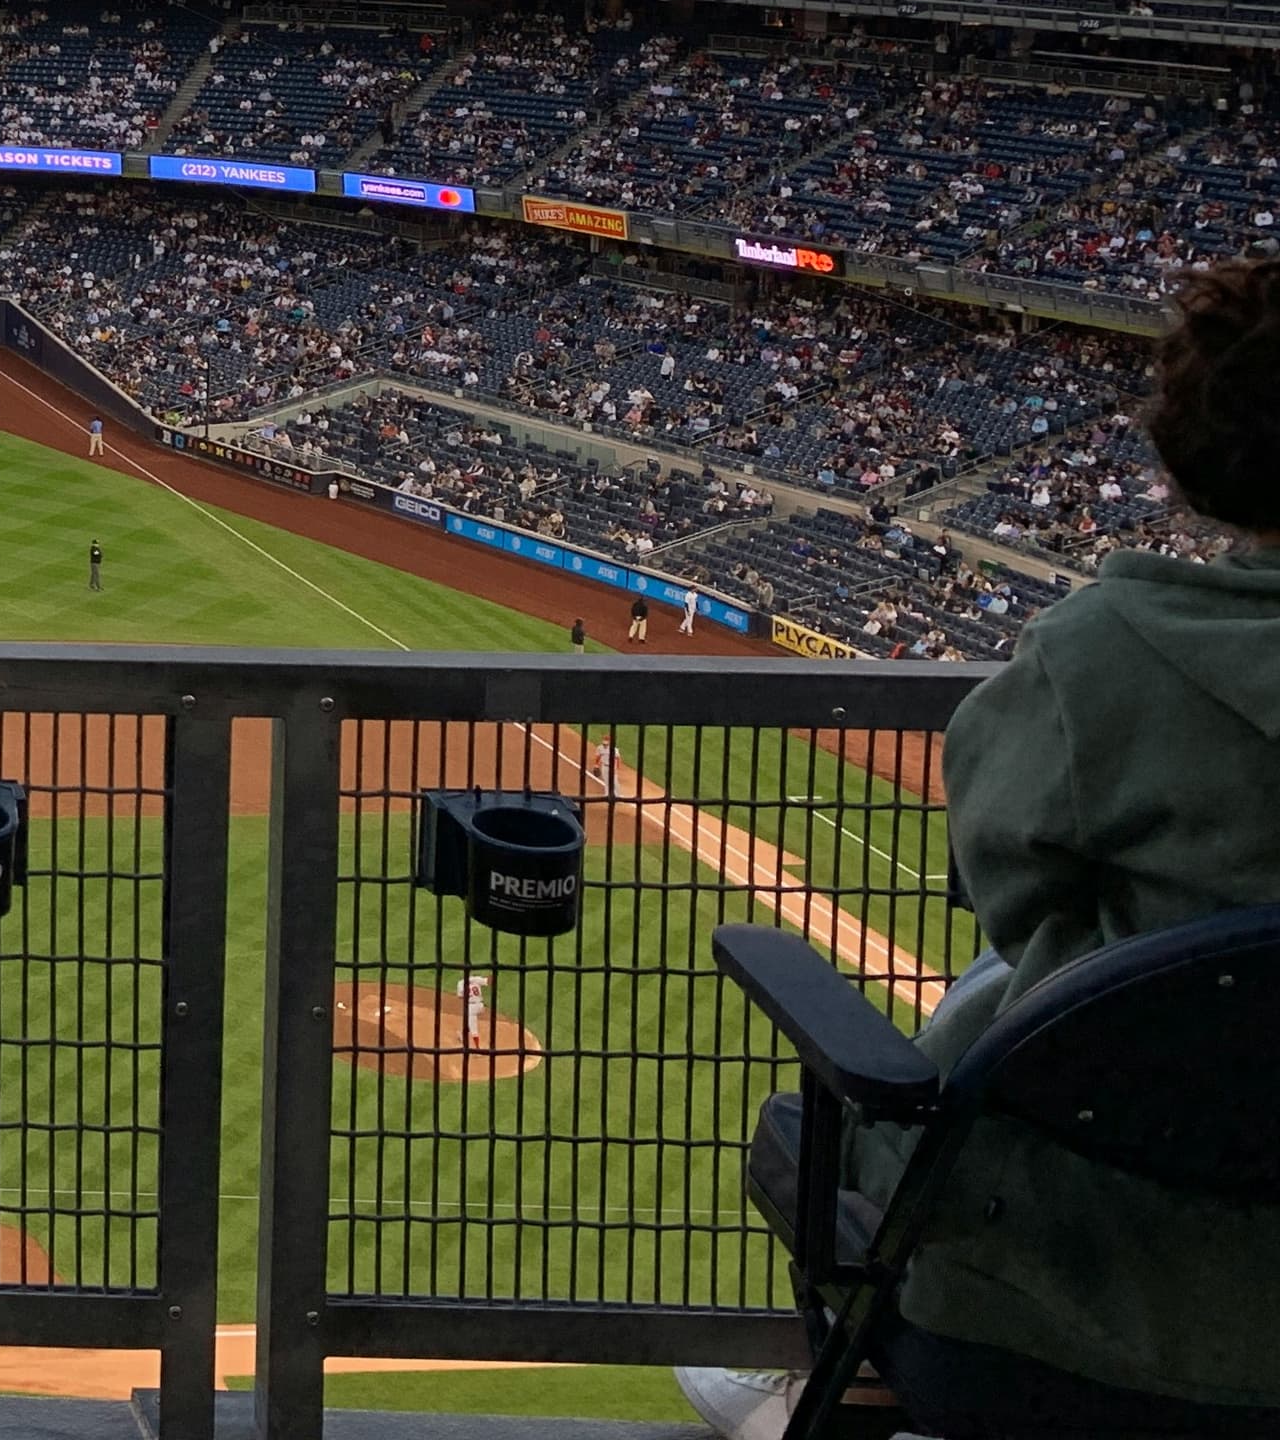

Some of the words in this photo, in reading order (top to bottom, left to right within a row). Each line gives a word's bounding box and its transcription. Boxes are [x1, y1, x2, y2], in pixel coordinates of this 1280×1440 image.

[44, 153, 113, 169] TICKETS
[181, 163, 217, 178] (212)
[220, 165, 286, 184] YANKEES
[362, 182, 425, 200] yankees.com
[568, 212, 623, 232] AMAZING
[735, 239, 797, 266] Timberland
[394, 496, 440, 521] GEICO
[477, 527, 495, 540] AT&T
[535, 546, 556, 560] AT&T
[598, 565, 618, 581] AT&T
[489, 871, 576, 899] PREMIO
